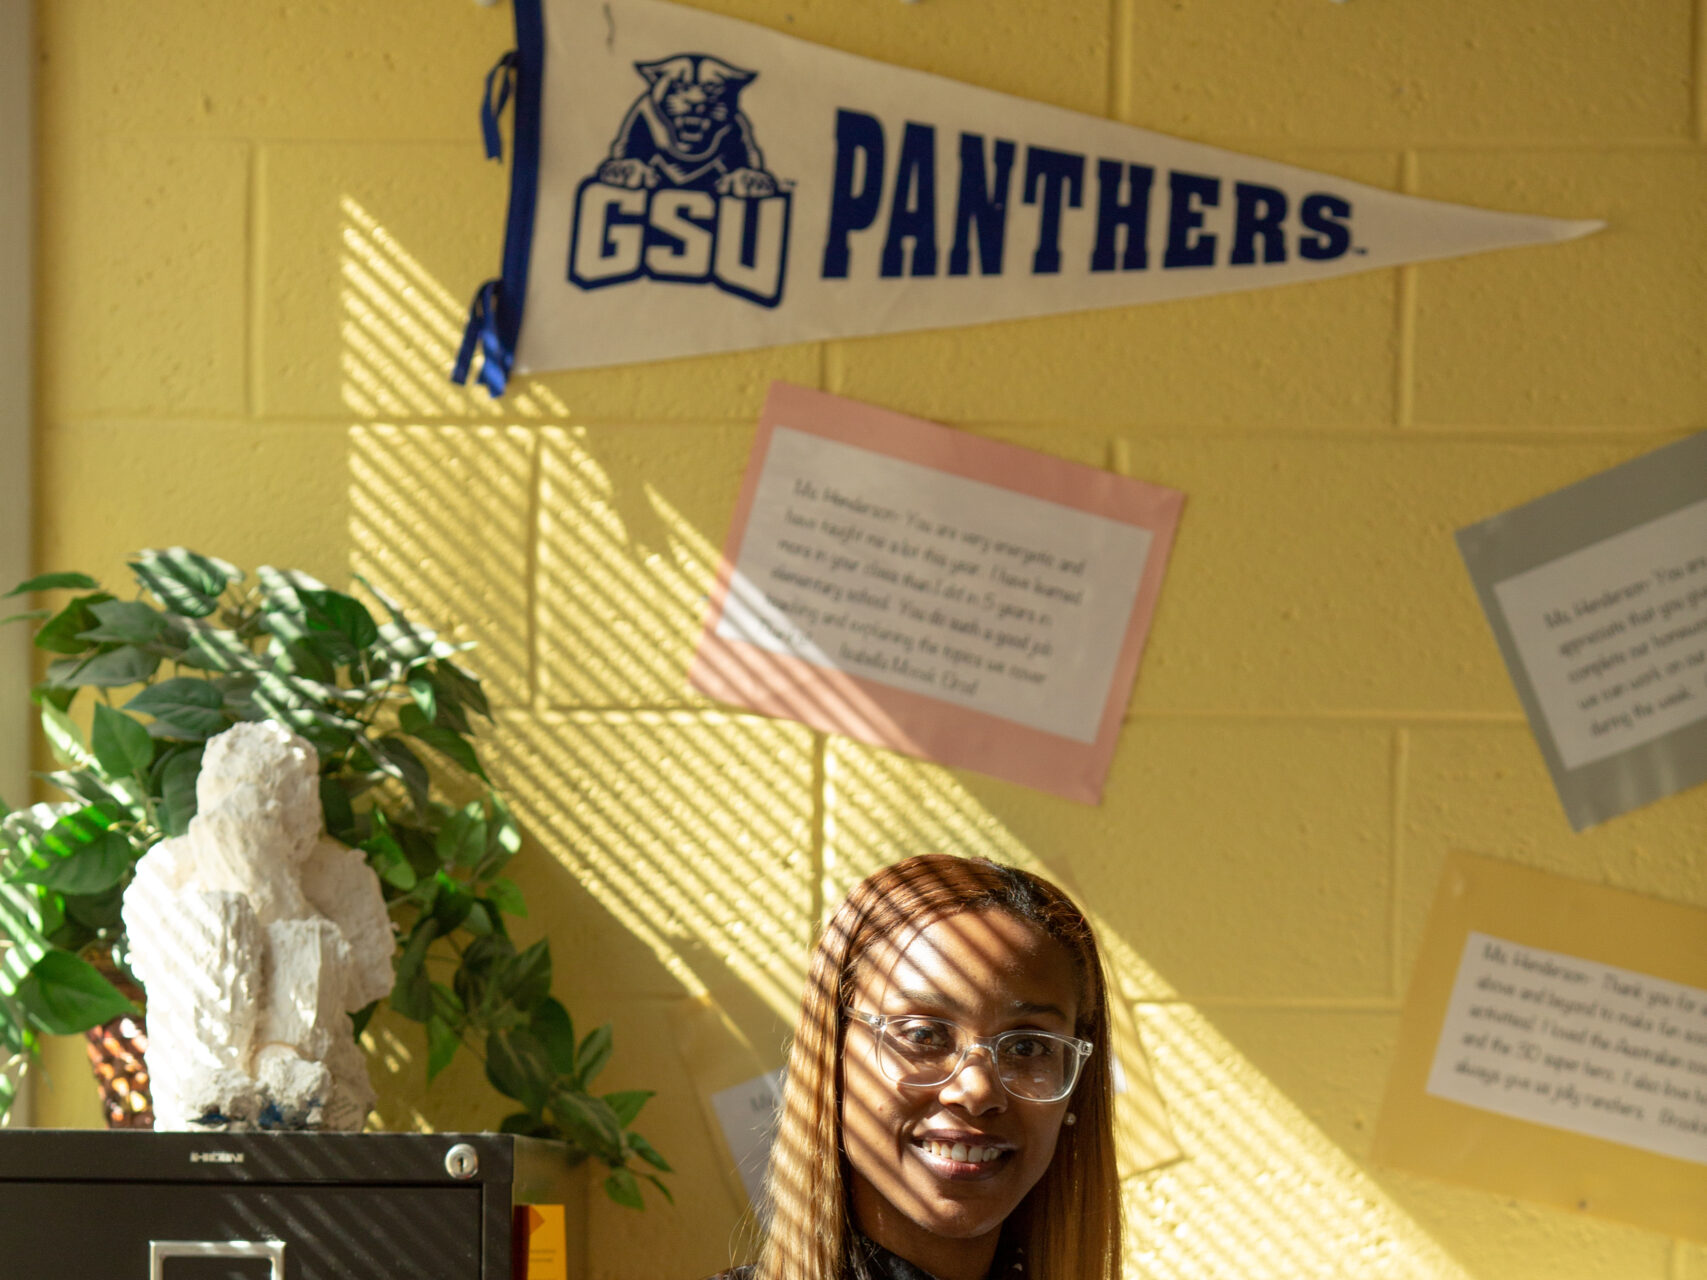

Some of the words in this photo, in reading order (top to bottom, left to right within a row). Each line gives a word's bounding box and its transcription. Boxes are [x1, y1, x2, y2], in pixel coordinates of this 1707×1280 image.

[567, 174, 791, 308] GSU
[821, 106, 1352, 279] PANTHERS
[1057, 559, 1086, 576] and
